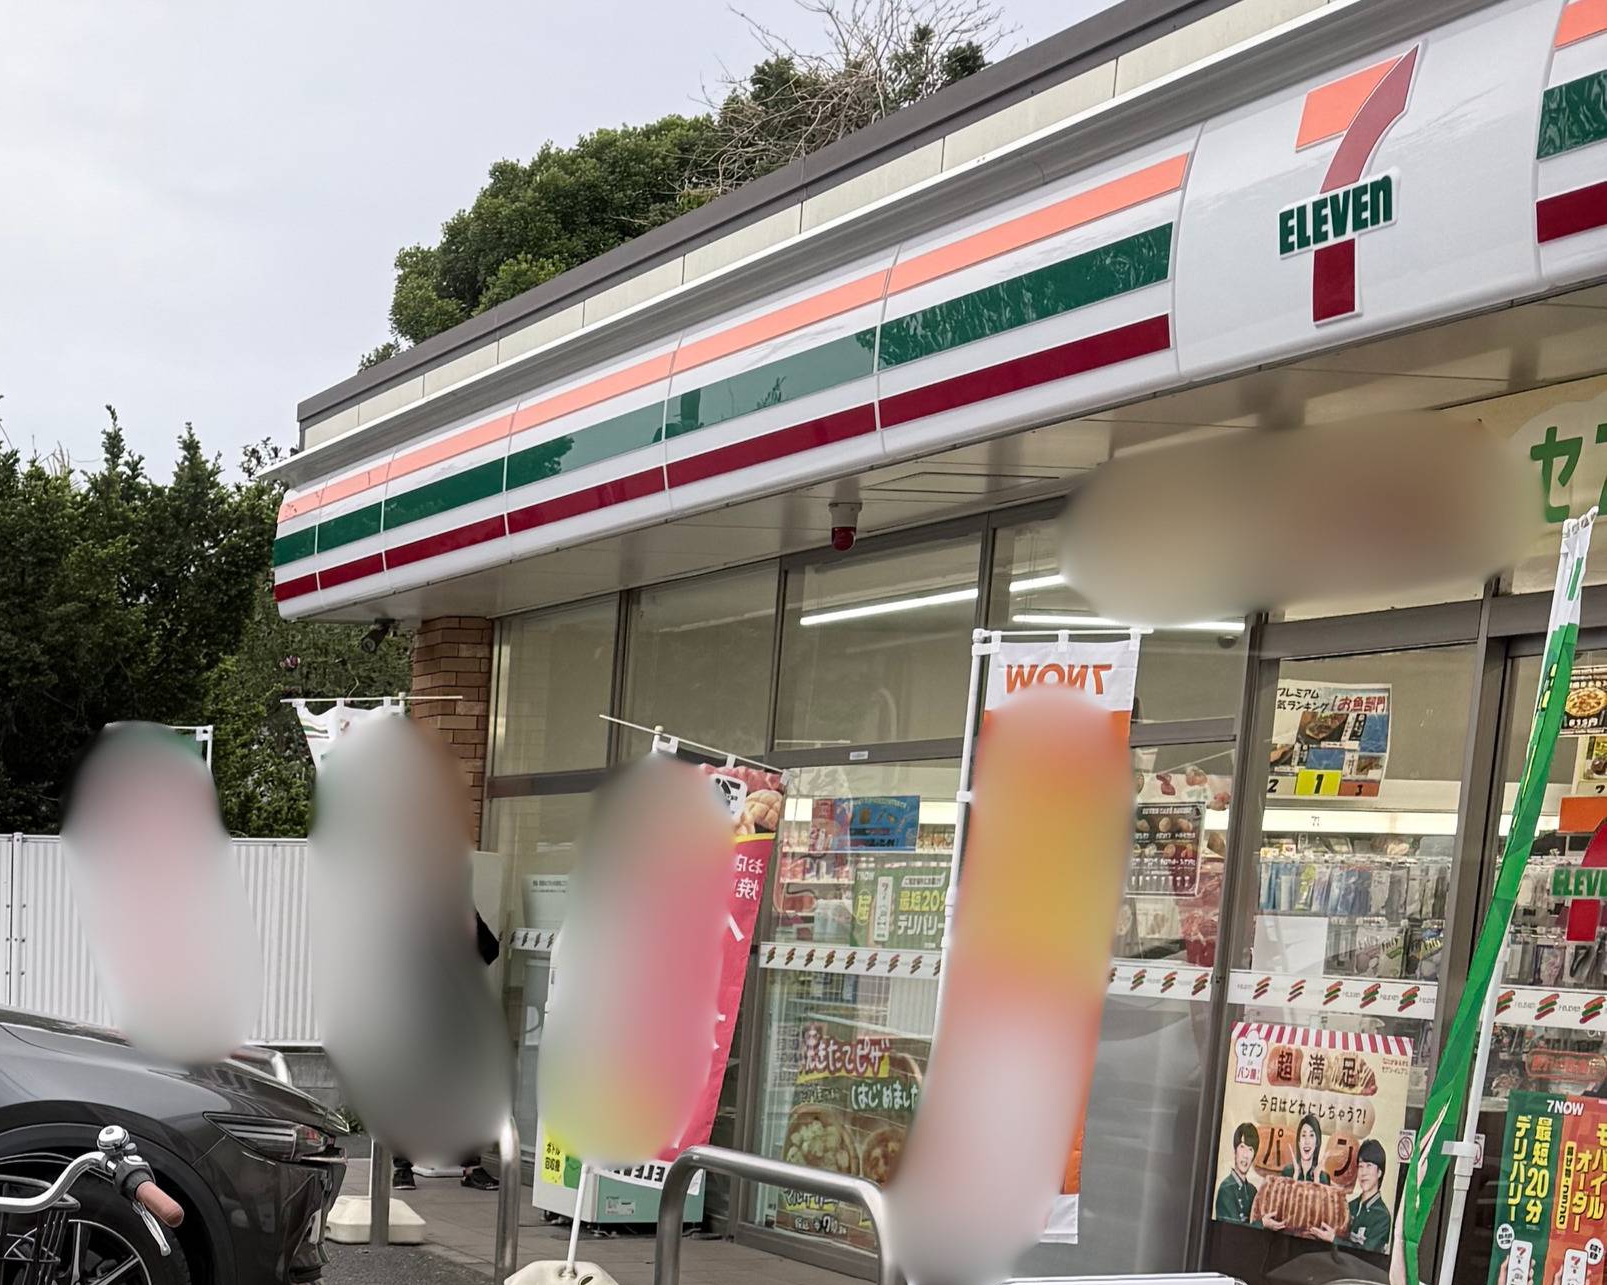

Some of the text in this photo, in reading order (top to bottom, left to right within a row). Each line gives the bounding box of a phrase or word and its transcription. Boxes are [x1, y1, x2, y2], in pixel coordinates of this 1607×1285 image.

[1296, 44, 1420, 323] 7
[1529, 423, 1607, 524] セ
[1338, 695, 1387, 713] お魚部門
[1267, 779, 1279, 793] 2
[1314, 773, 1325, 795] 1
[1355, 784, 1363, 796] 3
[1546, 1099, 1584, 1116] 7NOW
[1507, 1115, 1532, 1223] デリバリー
[1525, 1117, 1553, 1225] 最短20分
[1571, 1152, 1593, 1233] オーダー
